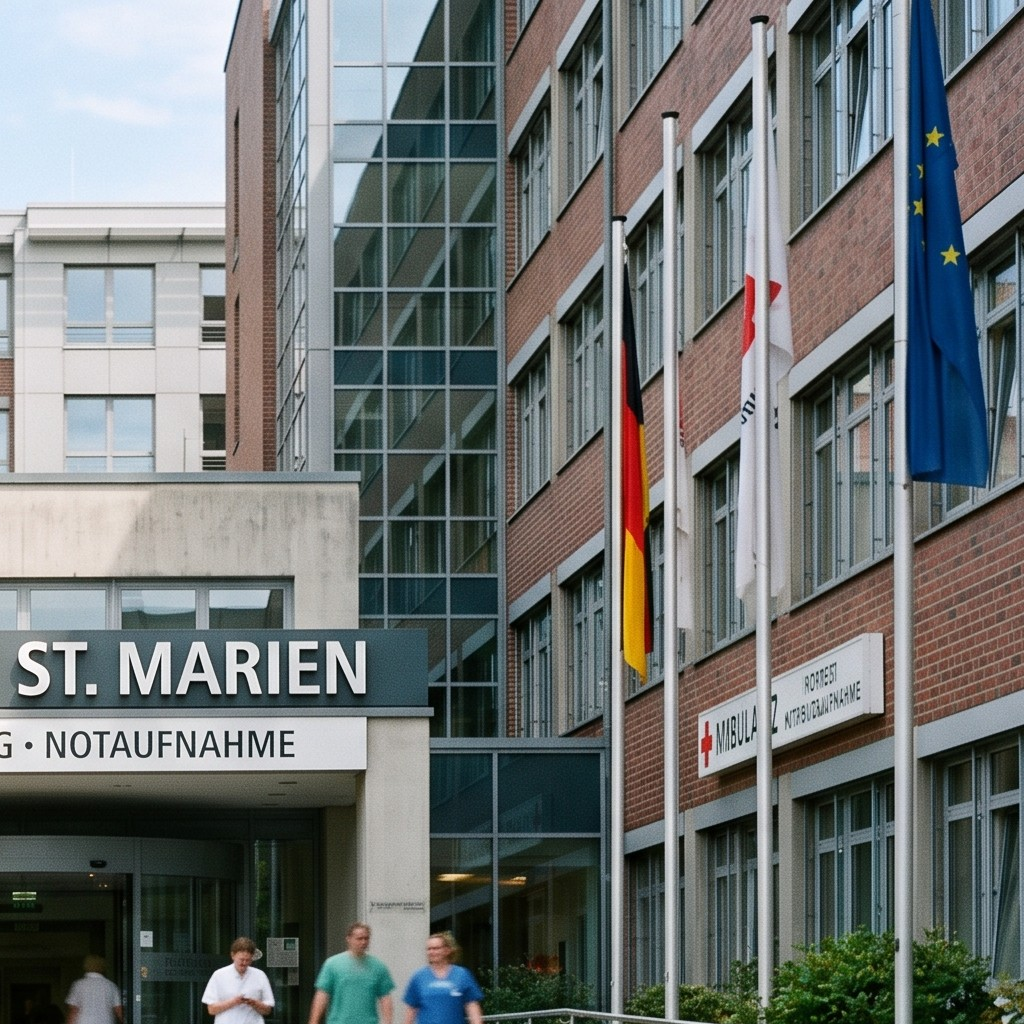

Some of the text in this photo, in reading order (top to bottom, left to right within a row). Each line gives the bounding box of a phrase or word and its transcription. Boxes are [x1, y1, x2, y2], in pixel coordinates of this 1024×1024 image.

[17, 640, 98, 697] ST.
[118, 640, 367, 696] MARIEN
[46, 730, 295, 759] NOTAUFNAHME
